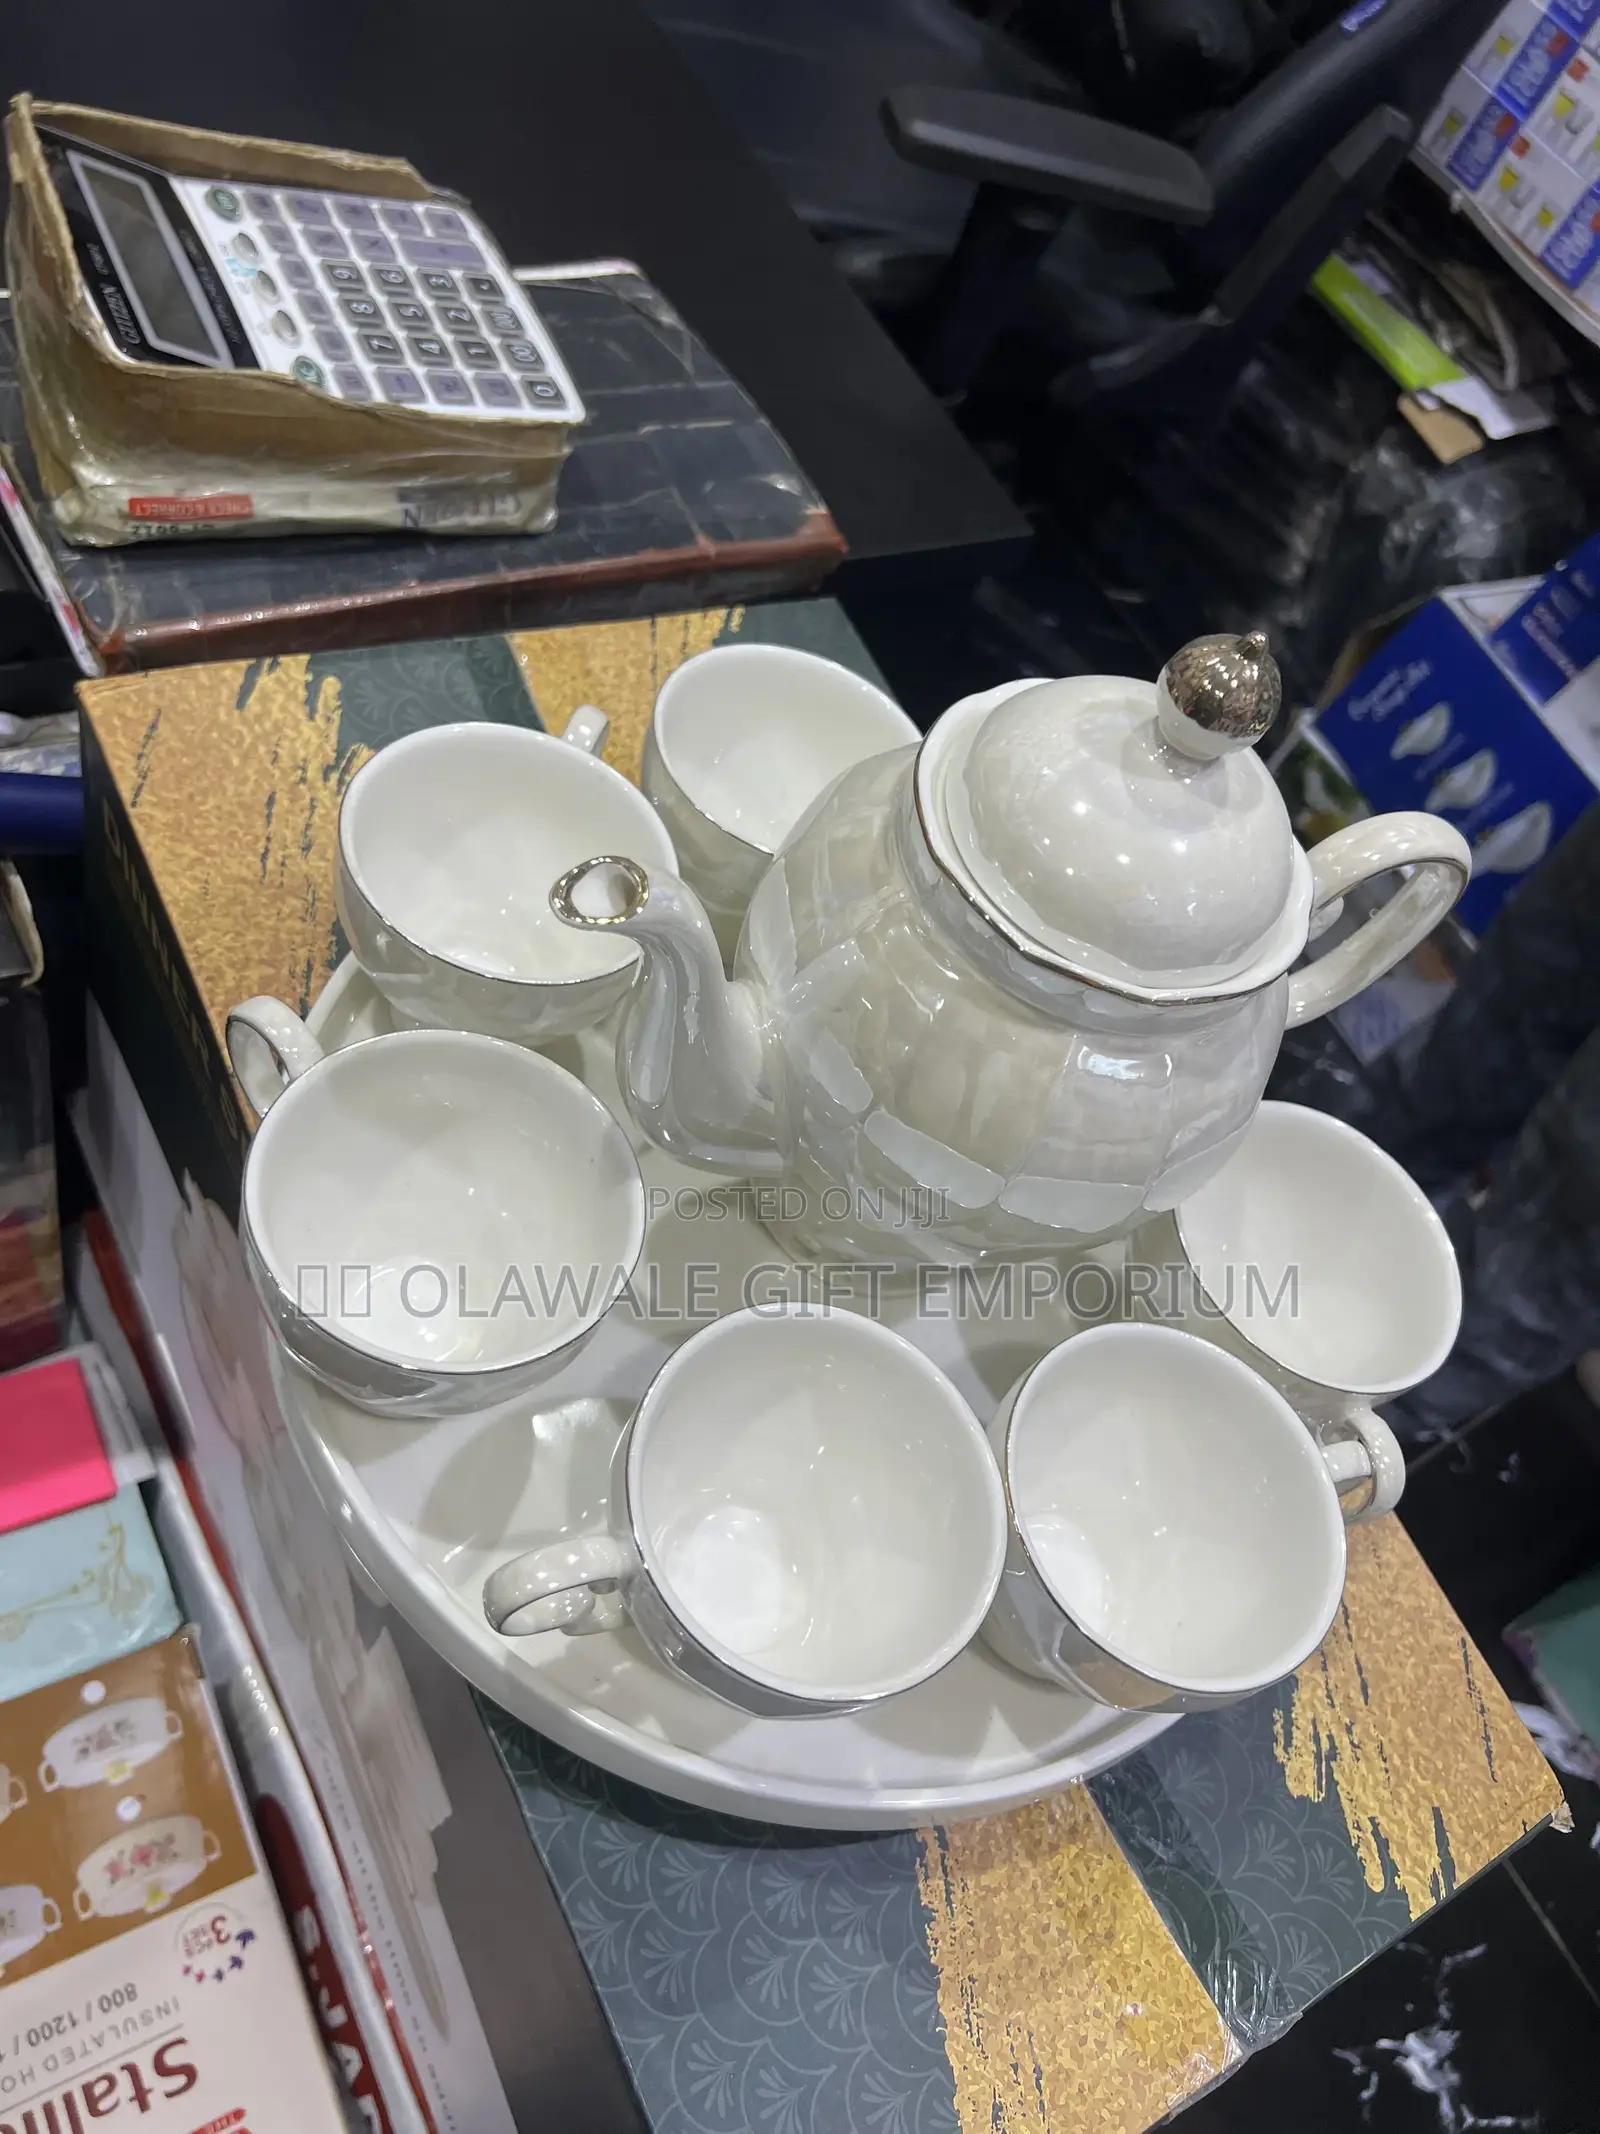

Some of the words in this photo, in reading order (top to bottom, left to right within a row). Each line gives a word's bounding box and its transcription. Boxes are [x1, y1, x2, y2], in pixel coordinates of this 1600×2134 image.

[332, 266, 357, 280] 9
[380, 268, 405, 284] 6
[428, 273, 453, 288] 3
[100, 283, 141, 345] CITIZEN
[350, 301, 375, 315] 8
[398, 304, 423, 318] 5
[447, 306, 471, 322] 2
[369, 337, 394, 350] 7
[418, 338, 441, 355] 4
[467, 346, 487, 356] 1
[532, 383, 557, 397] 0
[211, 1914, 231, 1944] 3
[97, 1982, 138, 2014] 800
[26, 2011, 80, 2048] 1200
[42, 1994, 181, 2073] INSULATED
